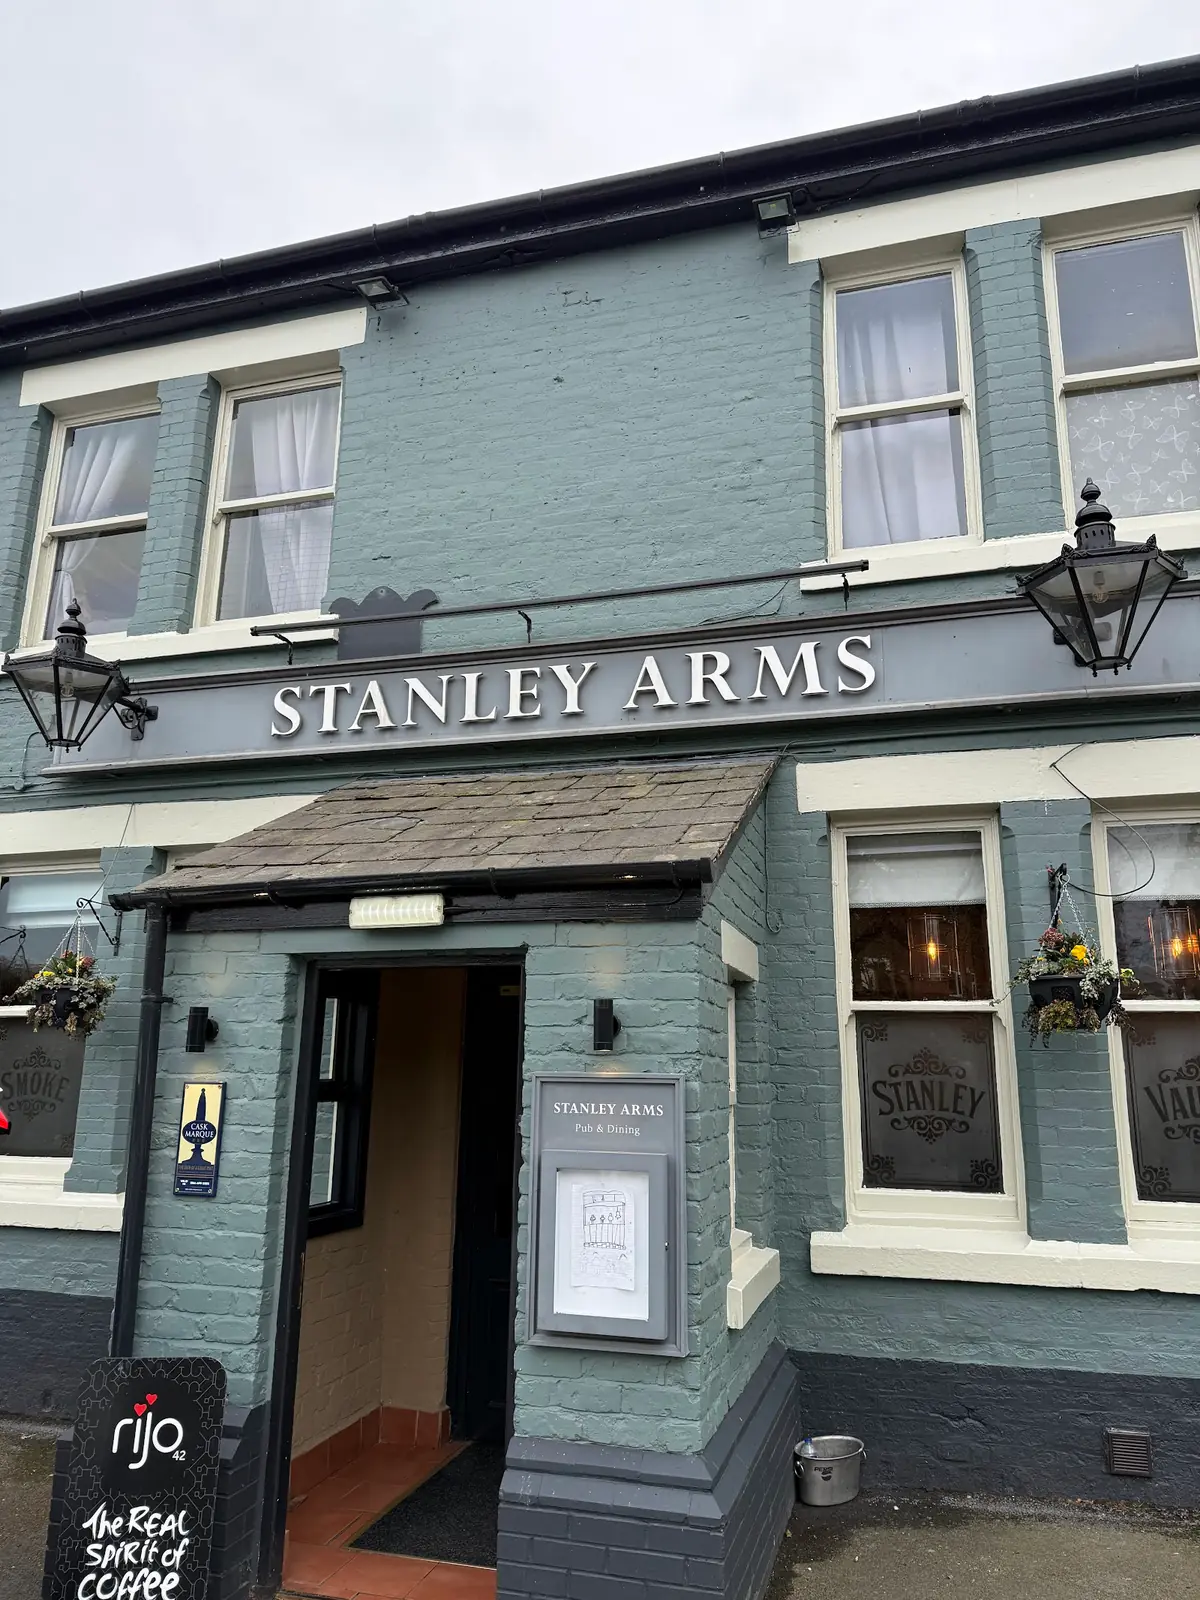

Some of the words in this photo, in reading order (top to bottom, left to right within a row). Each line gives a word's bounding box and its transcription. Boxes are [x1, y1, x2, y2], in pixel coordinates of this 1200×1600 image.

[271, 662, 597, 738] STANLEY
[622, 634, 877, 710] ARMS
[1, 1071, 70, 1102] SMOKE
[872, 1080, 986, 1119] STANLEY
[553, 1102, 617, 1115] STANLEY
[620, 1103, 664, 1117] ARMS
[184, 1130, 214, 1139] MARQUE
[190, 1122, 208, 1131] CASK
[575, 1123, 593, 1133] Pub
[596, 1124, 604, 1133] &
[607, 1124, 641, 1137] Dining
[112, 1394, 184, 1470] rijo
[172, 1450, 187, 1461] 42
[82, 1501, 124, 1540] The
[126, 1506, 190, 1540] REAL
[161, 1538, 189, 1570] of
